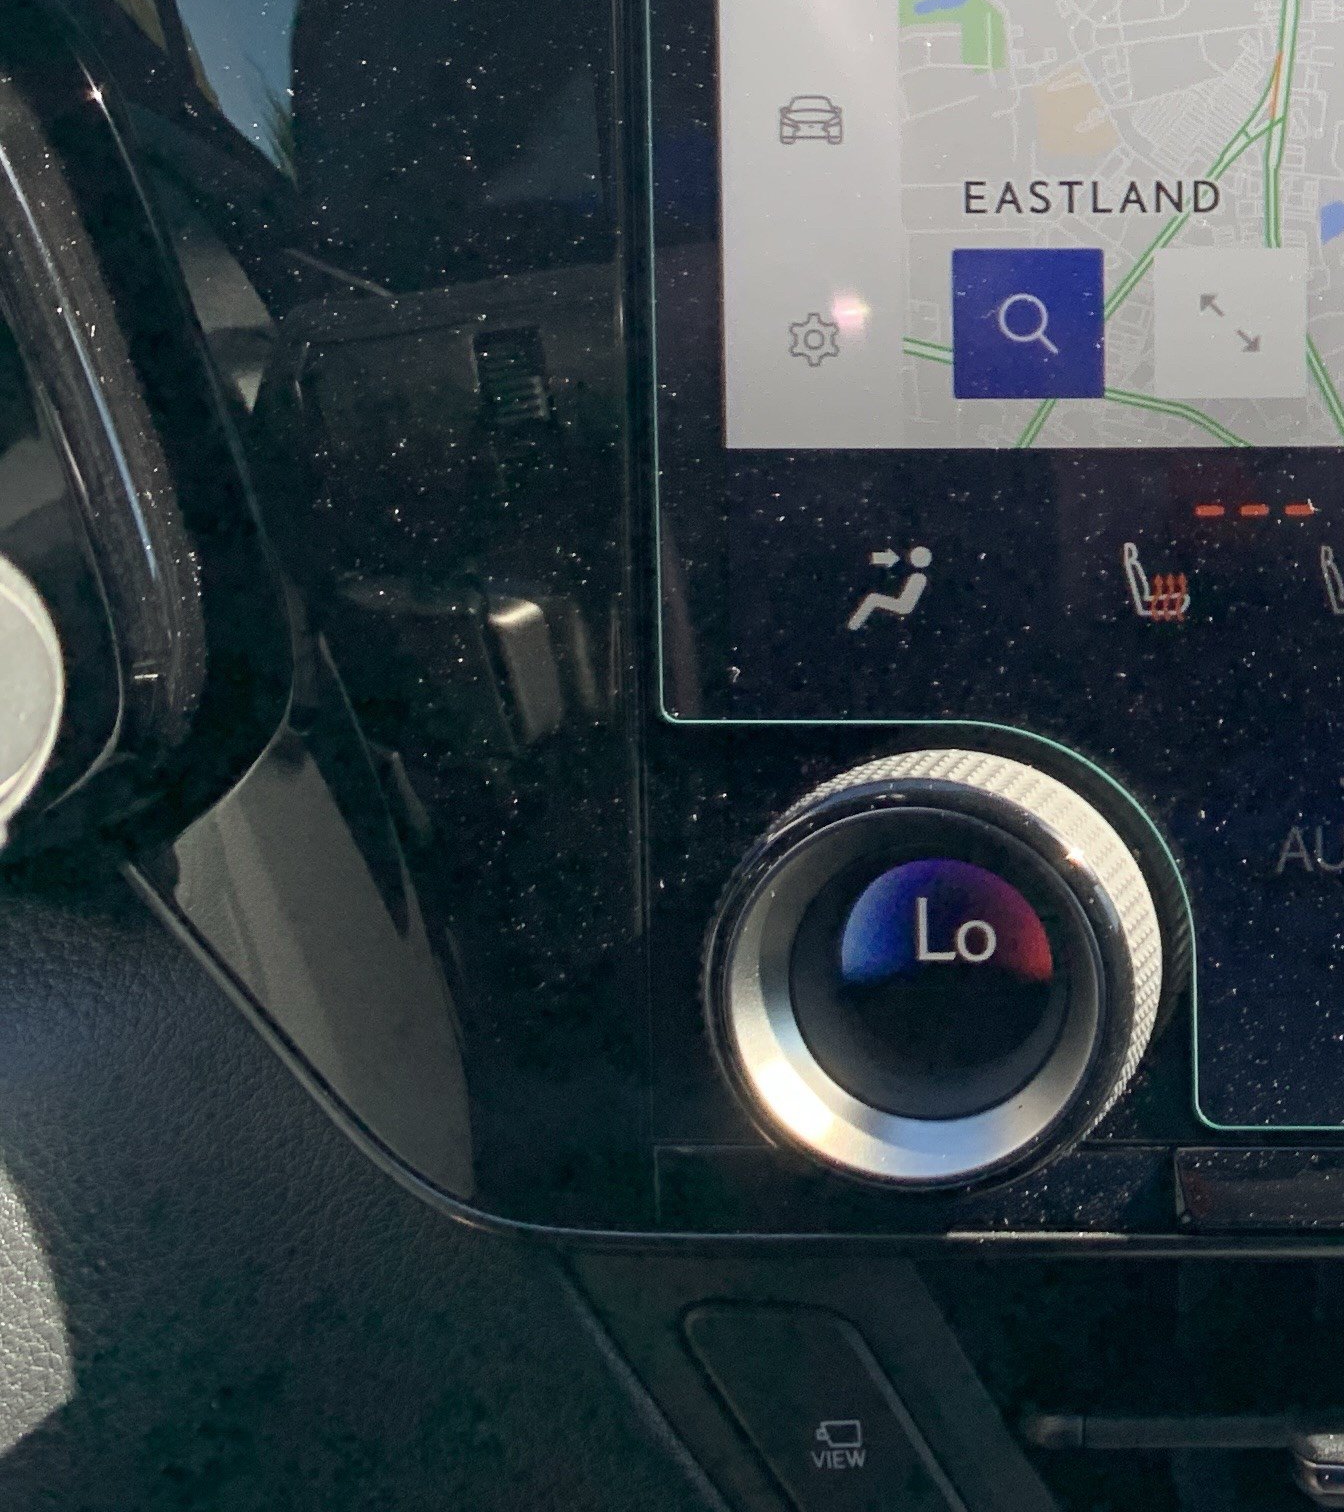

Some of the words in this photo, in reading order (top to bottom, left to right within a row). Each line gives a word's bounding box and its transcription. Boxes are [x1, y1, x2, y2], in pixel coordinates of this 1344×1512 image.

[963, 179, 1221, 215] EASTLAND
[914, 897, 996, 962] Lo
[811, 1450, 865, 1468] VIEW
